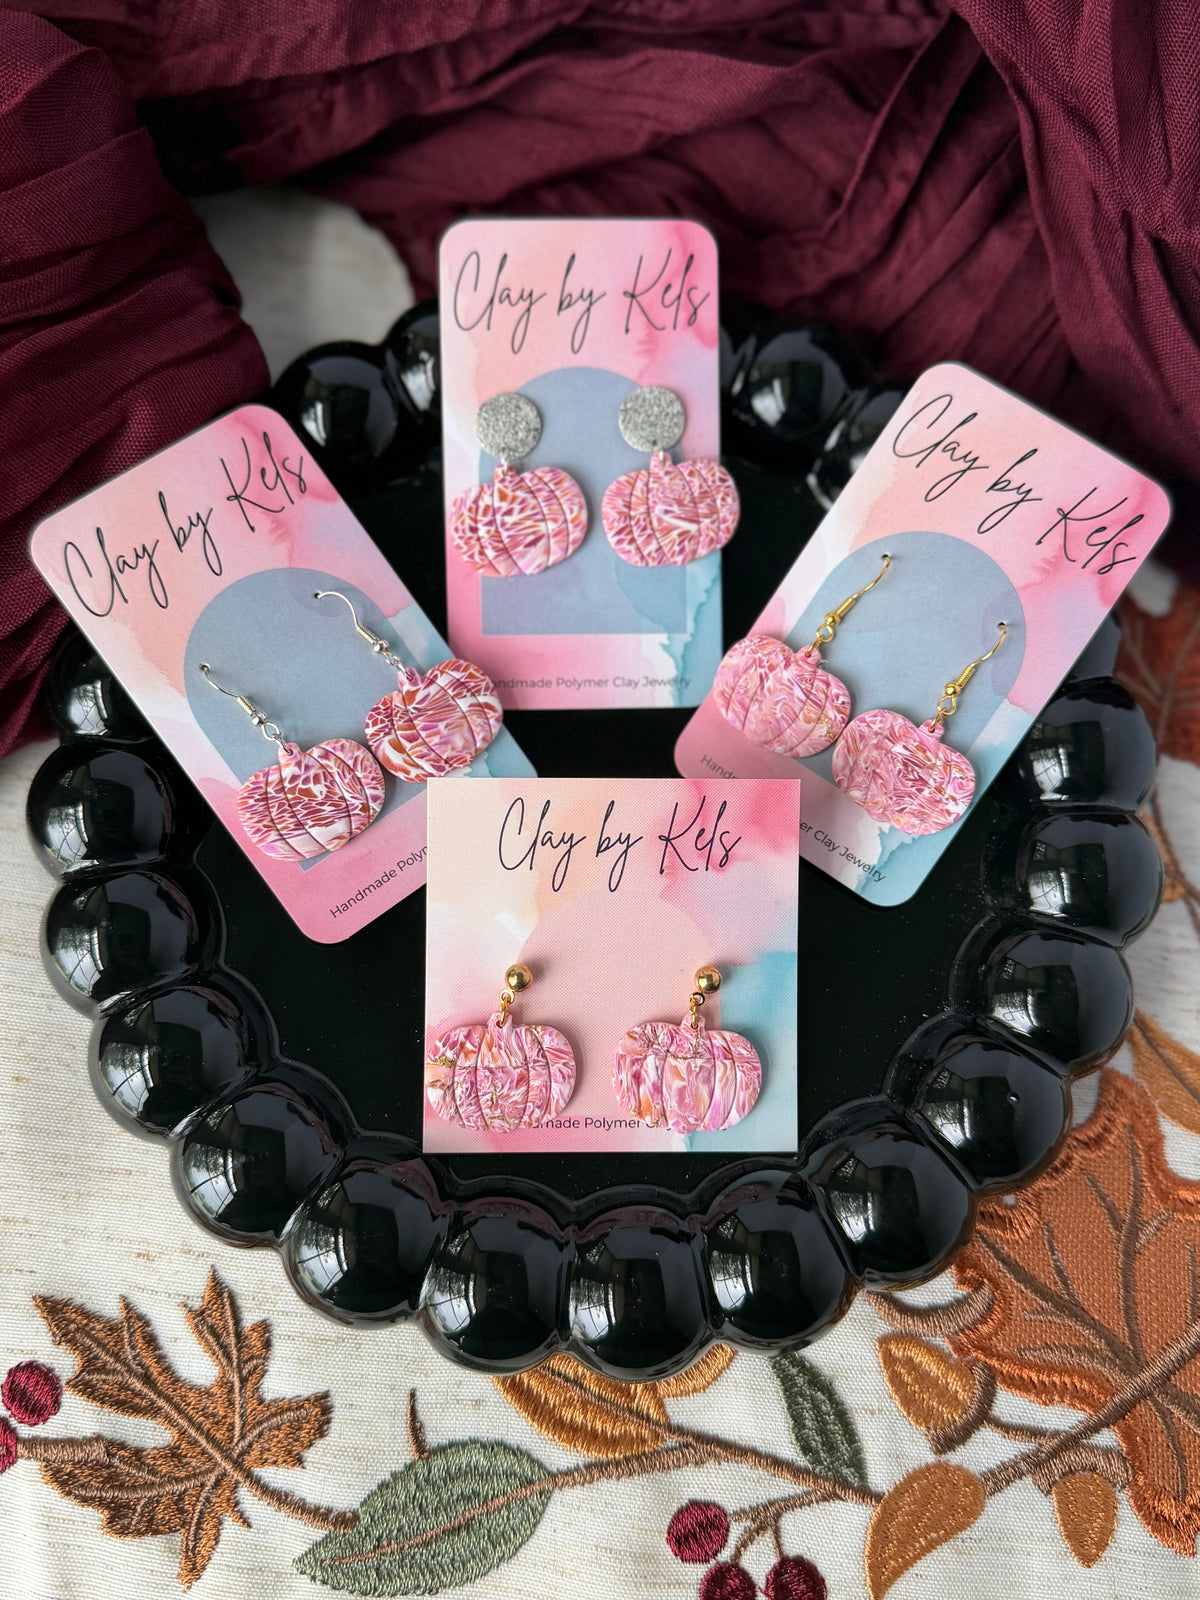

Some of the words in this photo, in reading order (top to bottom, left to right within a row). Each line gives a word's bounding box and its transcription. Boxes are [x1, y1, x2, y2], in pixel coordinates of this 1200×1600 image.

[454, 250, 547, 354] Clay
[556, 253, 607, 354] by
[623, 248, 711, 334] Kels
[64, 527, 168, 617] Clay
[158, 491, 223, 576] by
[220, 432, 307, 533] Kels
[892, 394, 989, 502] Clay
[977, 448, 1043, 534] by
[1036, 487, 1144, 575] Kels
[490, 676, 552, 689] andmade
[556, 676, 609, 690] Polymer
[612, 675, 640, 690] Clay
[642, 675, 692, 689] Jewelry
[499, 797, 587, 892] Clay
[596, 799, 644, 892] by
[658, 795, 742, 875] Kels
[701, 754, 738, 779] Hand
[814, 830, 841, 852] Clay
[839, 847, 886, 883] Jewelry
[330, 869, 398, 918] Handmade
[585, 1117, 640, 1131] Polymer
